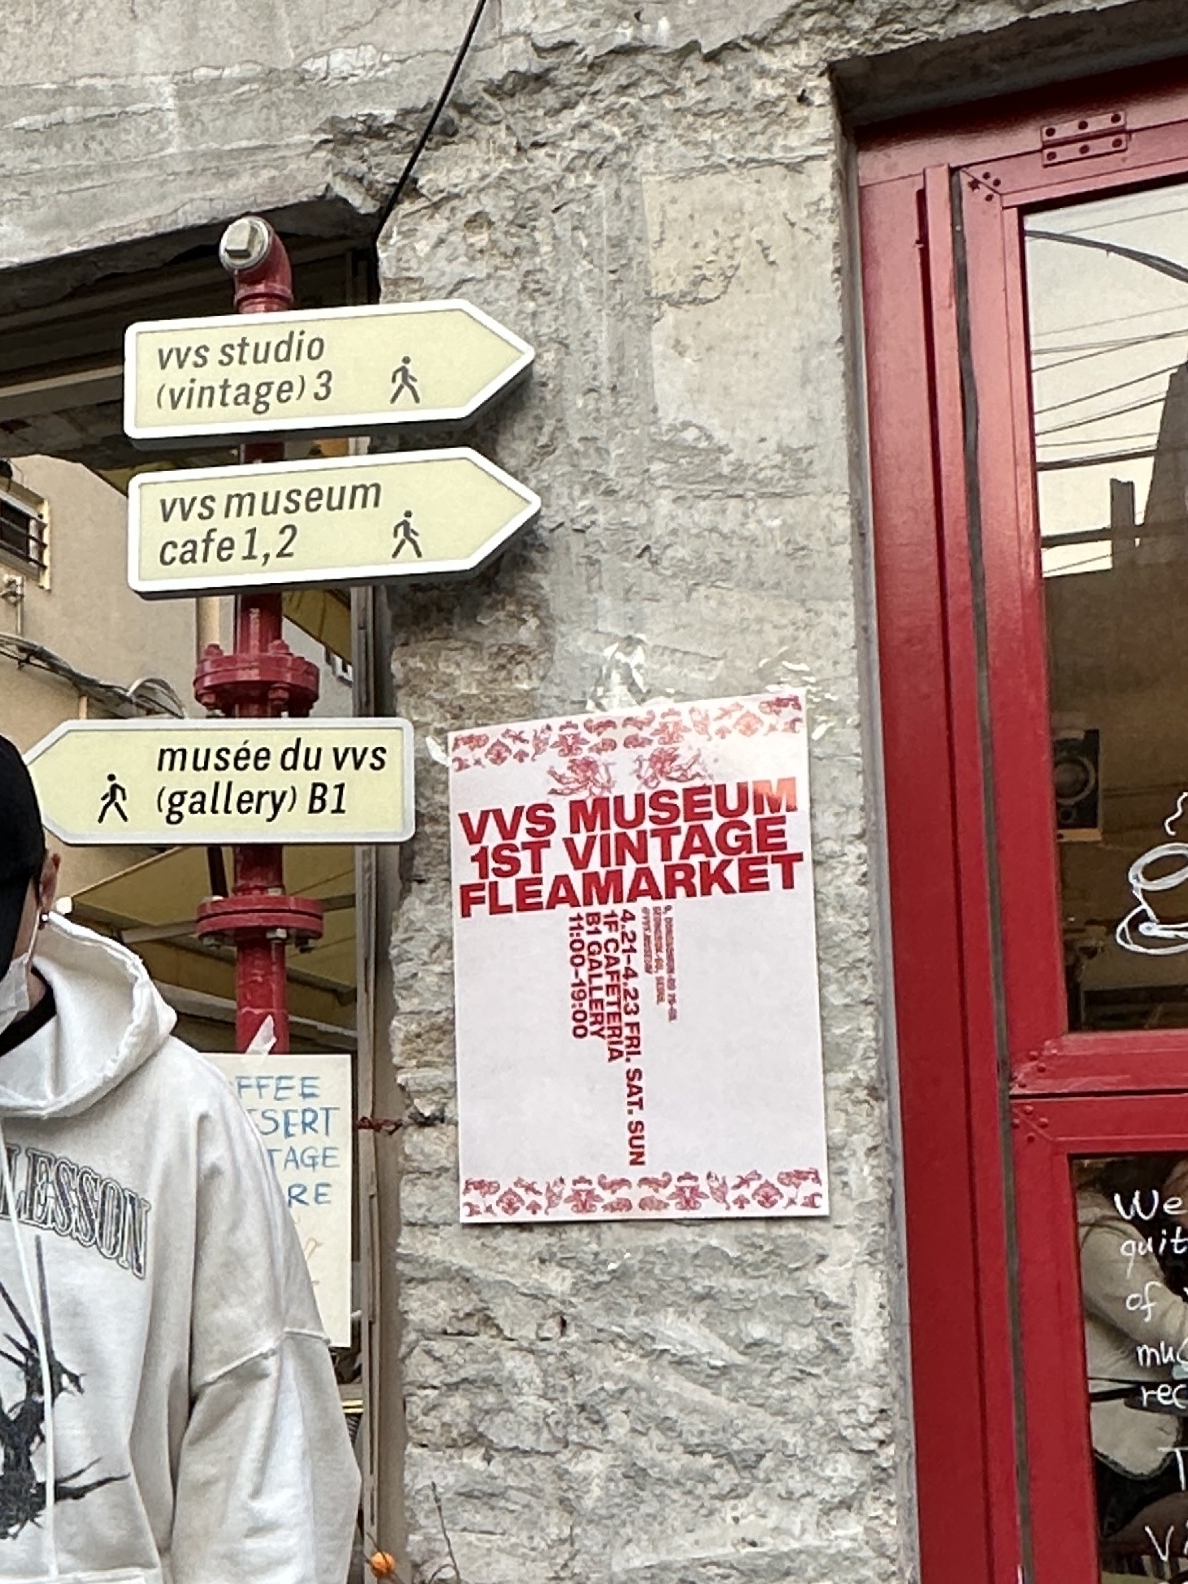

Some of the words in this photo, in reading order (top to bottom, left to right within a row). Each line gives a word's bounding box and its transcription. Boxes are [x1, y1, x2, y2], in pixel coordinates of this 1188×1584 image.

[157, 340, 210, 371] vvs
[218, 331, 326, 366] studio
[156, 375, 306, 415] (vintage)
[313, 371, 334, 402] 3
[159, 495, 215, 522] vvs
[224, 481, 383, 519] museum
[159, 528, 236, 567] cafe
[242, 525, 298, 567] 1,2
[156, 739, 272, 772] musée
[280, 739, 328, 772] du
[332, 745, 387, 771] vvs
[156, 783, 297, 824] (gallery)
[308, 783, 348, 815] B1
[458, 803, 557, 846] VVS
[569, 777, 798, 836] MUSEUM
[470, 839, 551, 880] 1ST
[563, 816, 788, 871] VINTAGE
[459, 852, 804, 918] FLEAMARKET
[585, 911, 602, 936] B1
[603, 910, 619, 933] 1F
[569, 912, 588, 1039] 11:00-19:00
[620, 908, 640, 1016] 4.21-4.23
[587, 940, 606, 1040] GALLERY
[603, 938, 624, 1063] CAFETERIA
[624, 1021, 642, 1063] FRI.
[229, 1075, 321, 1101] FFEE
[625, 1068, 644, 1115] SAT.
[246, 1107, 340, 1138] SERT
[627, 1120, 646, 1166] SUN
[1113, 1189, 1188, 1221] We
[1125, 1281, 1161, 1323] of
